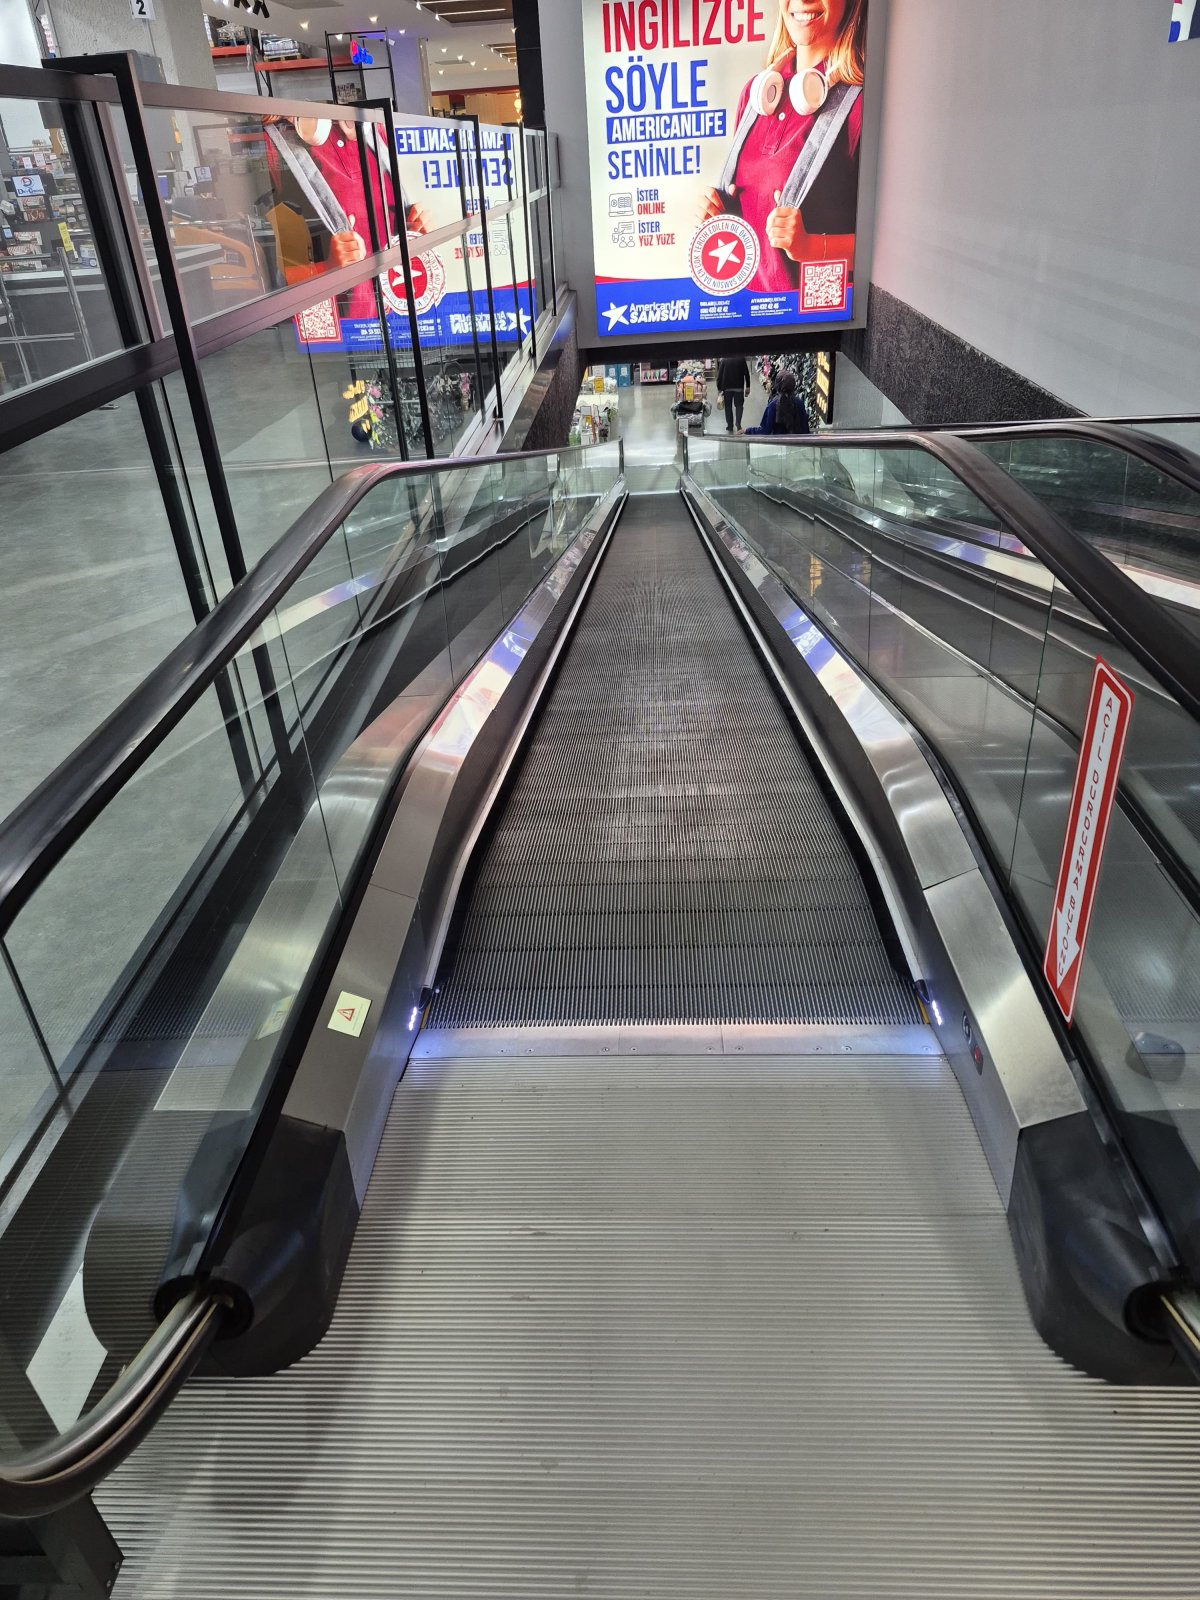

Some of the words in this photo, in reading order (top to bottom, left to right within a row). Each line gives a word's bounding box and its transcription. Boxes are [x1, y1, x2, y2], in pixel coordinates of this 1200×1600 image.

[136, 0, 146, 15] 2
[605, 55, 708, 113] SÖYLE
[611, 112, 724, 142] AMERICANLIFE
[608, 143, 700, 180] SENİNLE!
[636, 187, 659, 202] İSTER
[637, 202, 666, 215] ONLINE
[638, 219, 661, 234] İSTER
[638, 234, 654, 247] YÜZ
[655, 233, 676, 246] YÜZE
[629, 309, 689, 324] SAMSUN
[1073, 769, 1099, 891] DURDURMA
